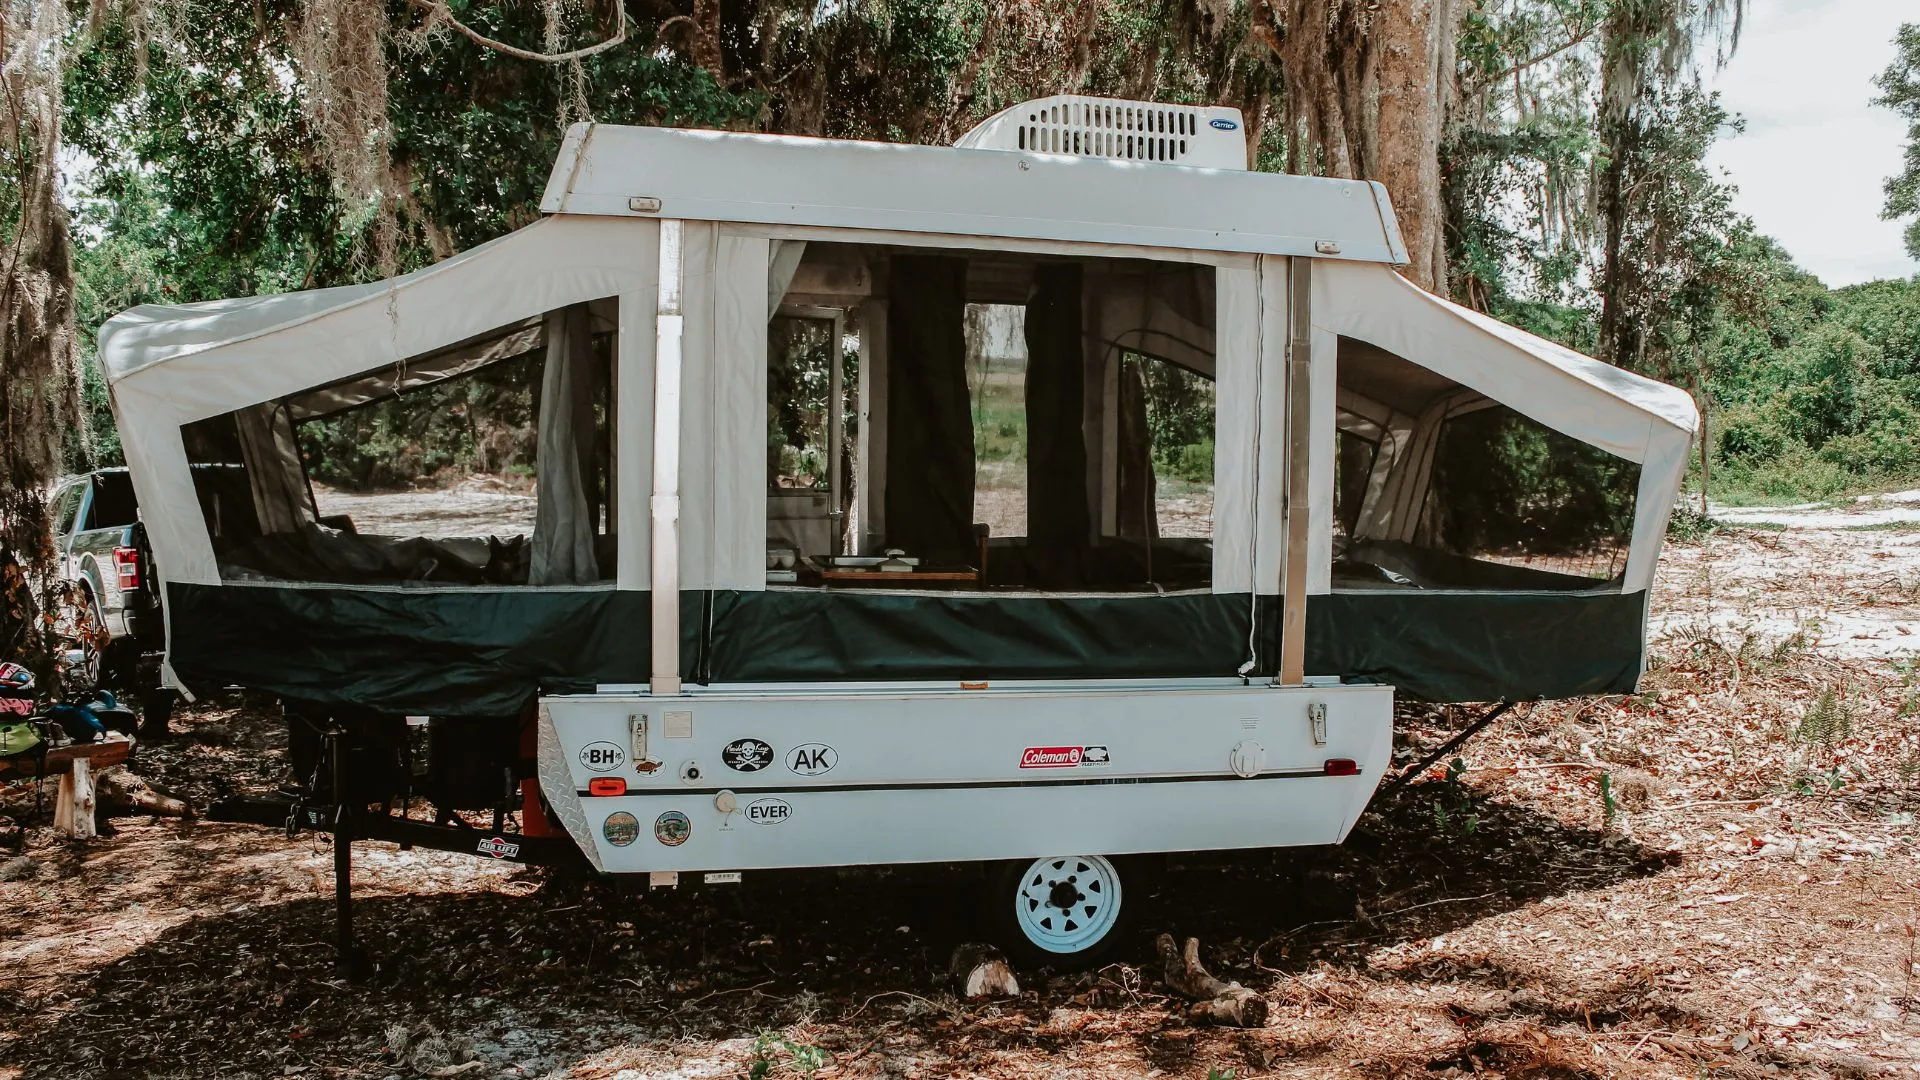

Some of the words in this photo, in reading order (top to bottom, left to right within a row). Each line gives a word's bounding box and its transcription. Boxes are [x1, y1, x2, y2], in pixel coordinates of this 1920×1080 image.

[1212, 121, 1235, 129] Carrier
[590, 749, 615, 764] BH
[793, 748, 829, 770] AK
[1024, 749, 1068, 763] Coleman
[750, 805, 788, 818] EVER
[480, 842, 496, 850] AIR
[497, 845, 516, 853] LIFT
